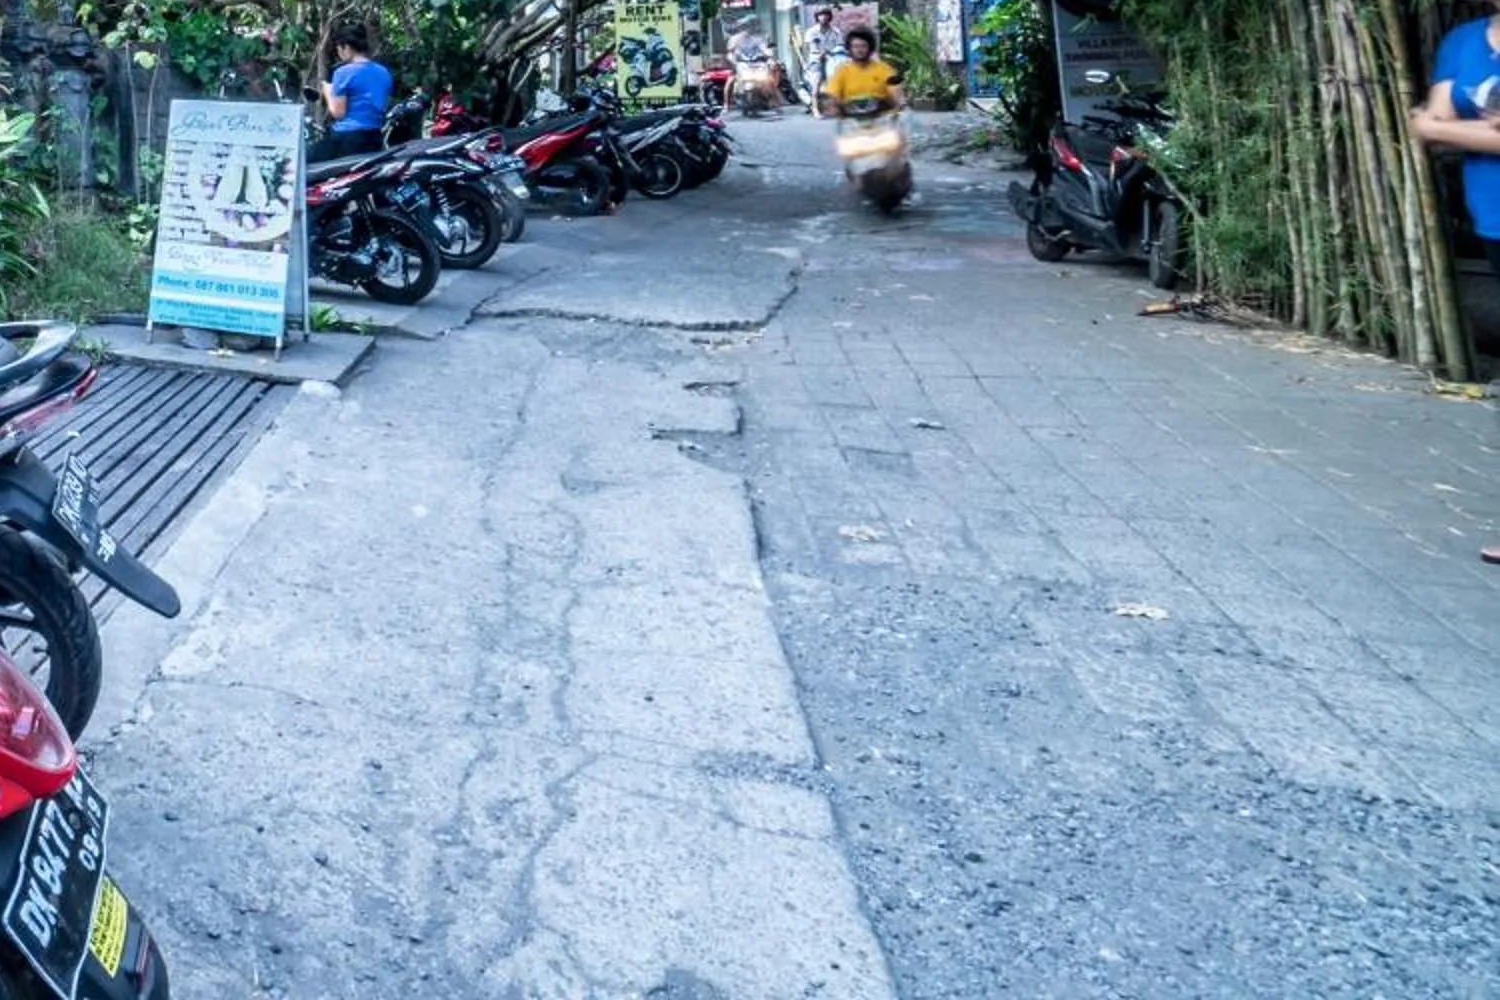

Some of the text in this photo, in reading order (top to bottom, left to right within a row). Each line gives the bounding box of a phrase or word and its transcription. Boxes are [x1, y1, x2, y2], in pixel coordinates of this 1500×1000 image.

[625, 5, 666, 16] RENT
[32, 800, 76, 895] 8477
[19, 877, 58, 948] DK
